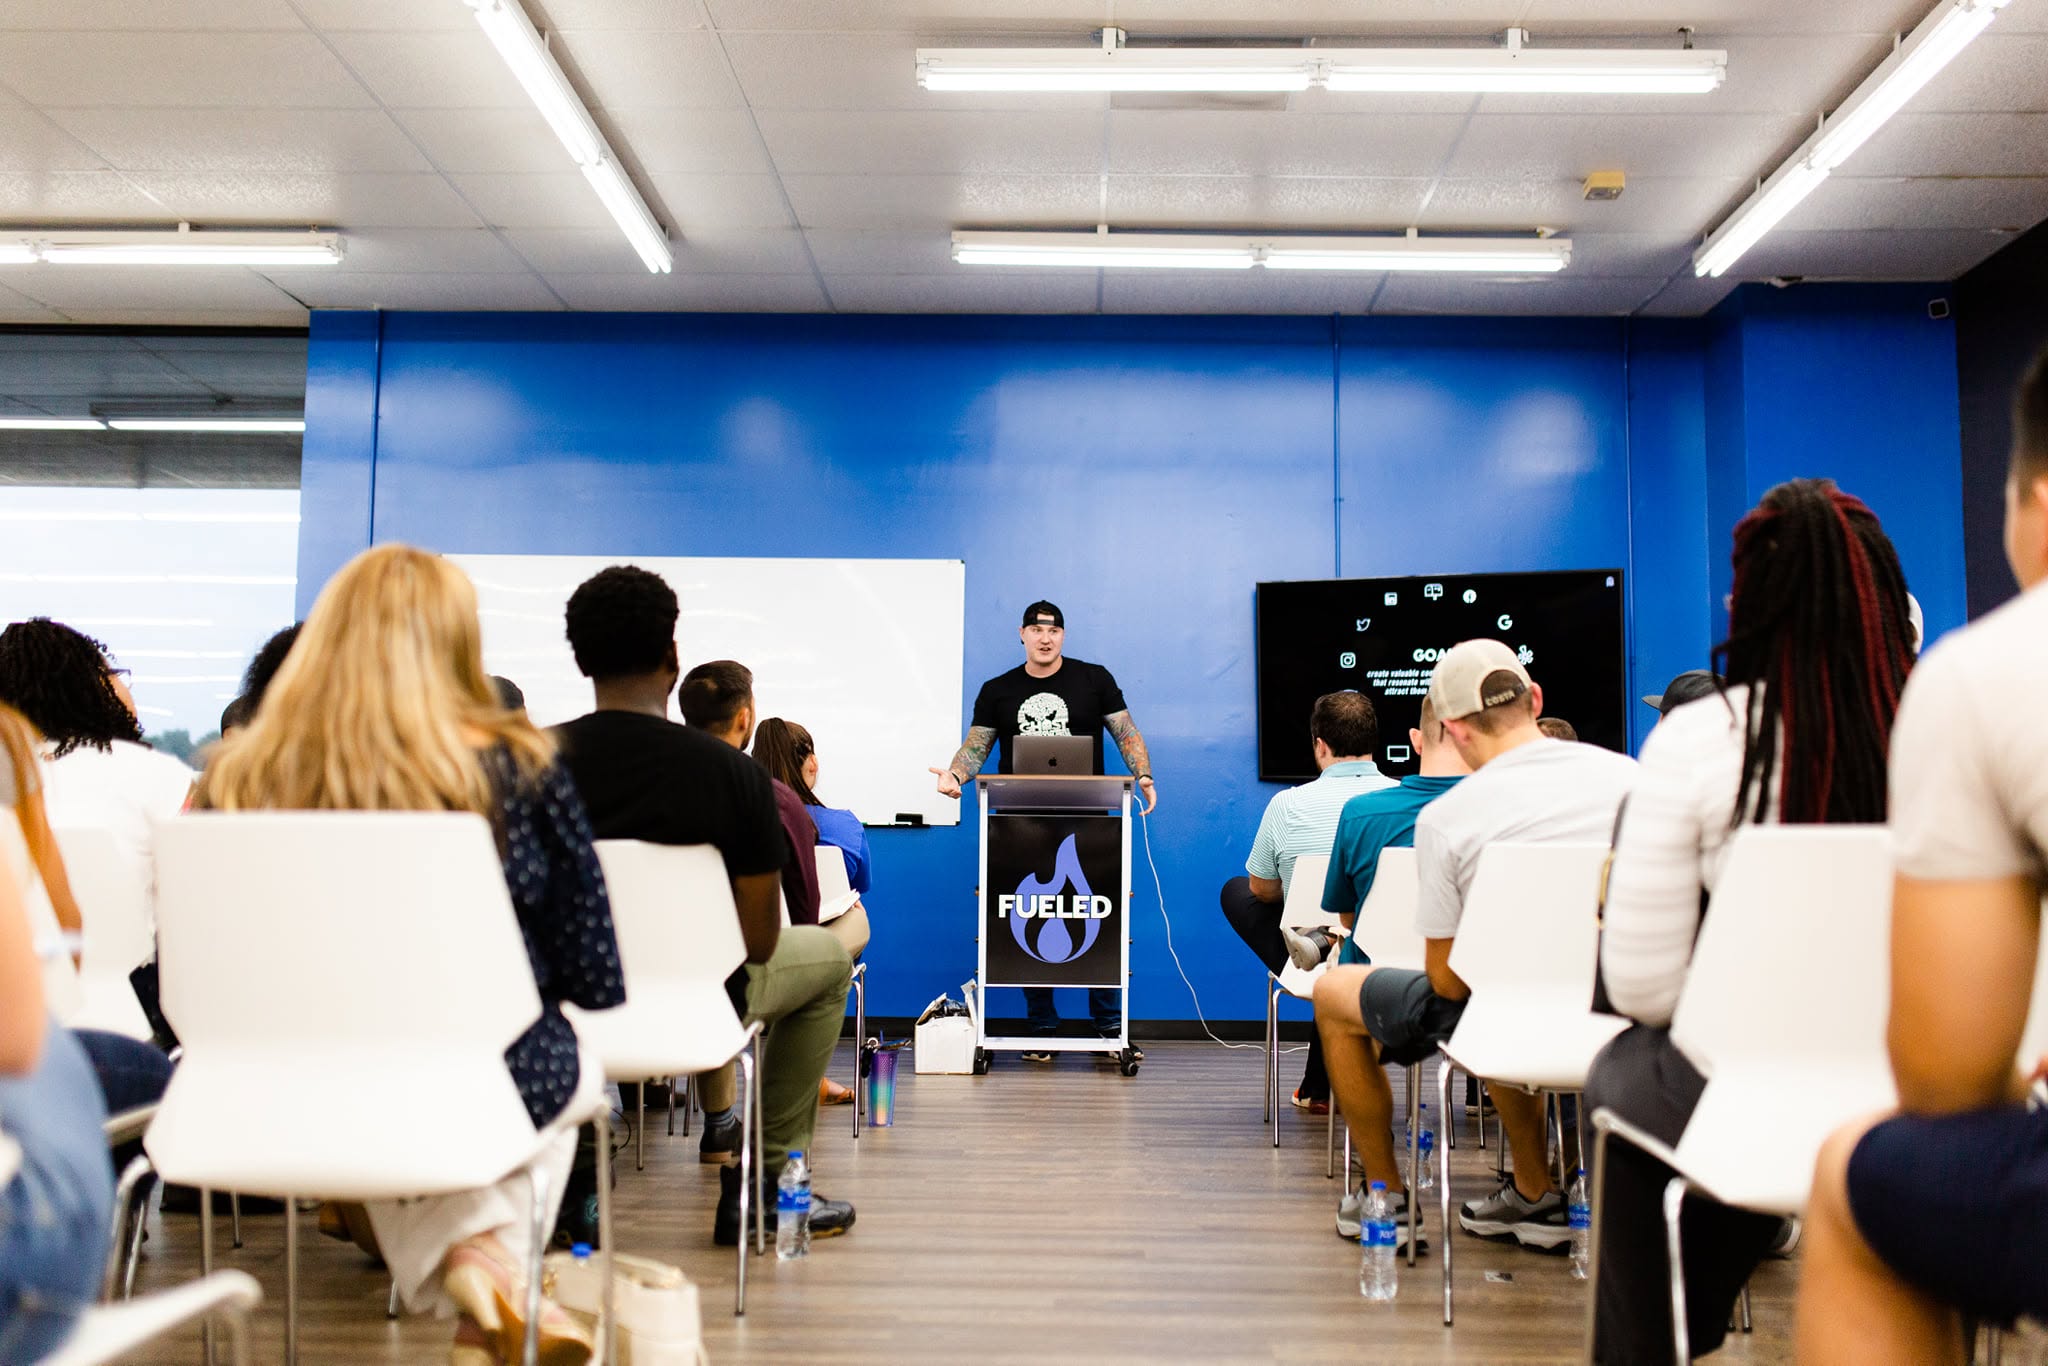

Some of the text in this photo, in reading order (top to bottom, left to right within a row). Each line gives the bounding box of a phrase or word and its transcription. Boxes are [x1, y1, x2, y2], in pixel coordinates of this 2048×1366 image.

[1366, 670, 1389, 678] create
[1410, 687, 1427, 695] them
[998, 894, 1113, 919] FUELED
